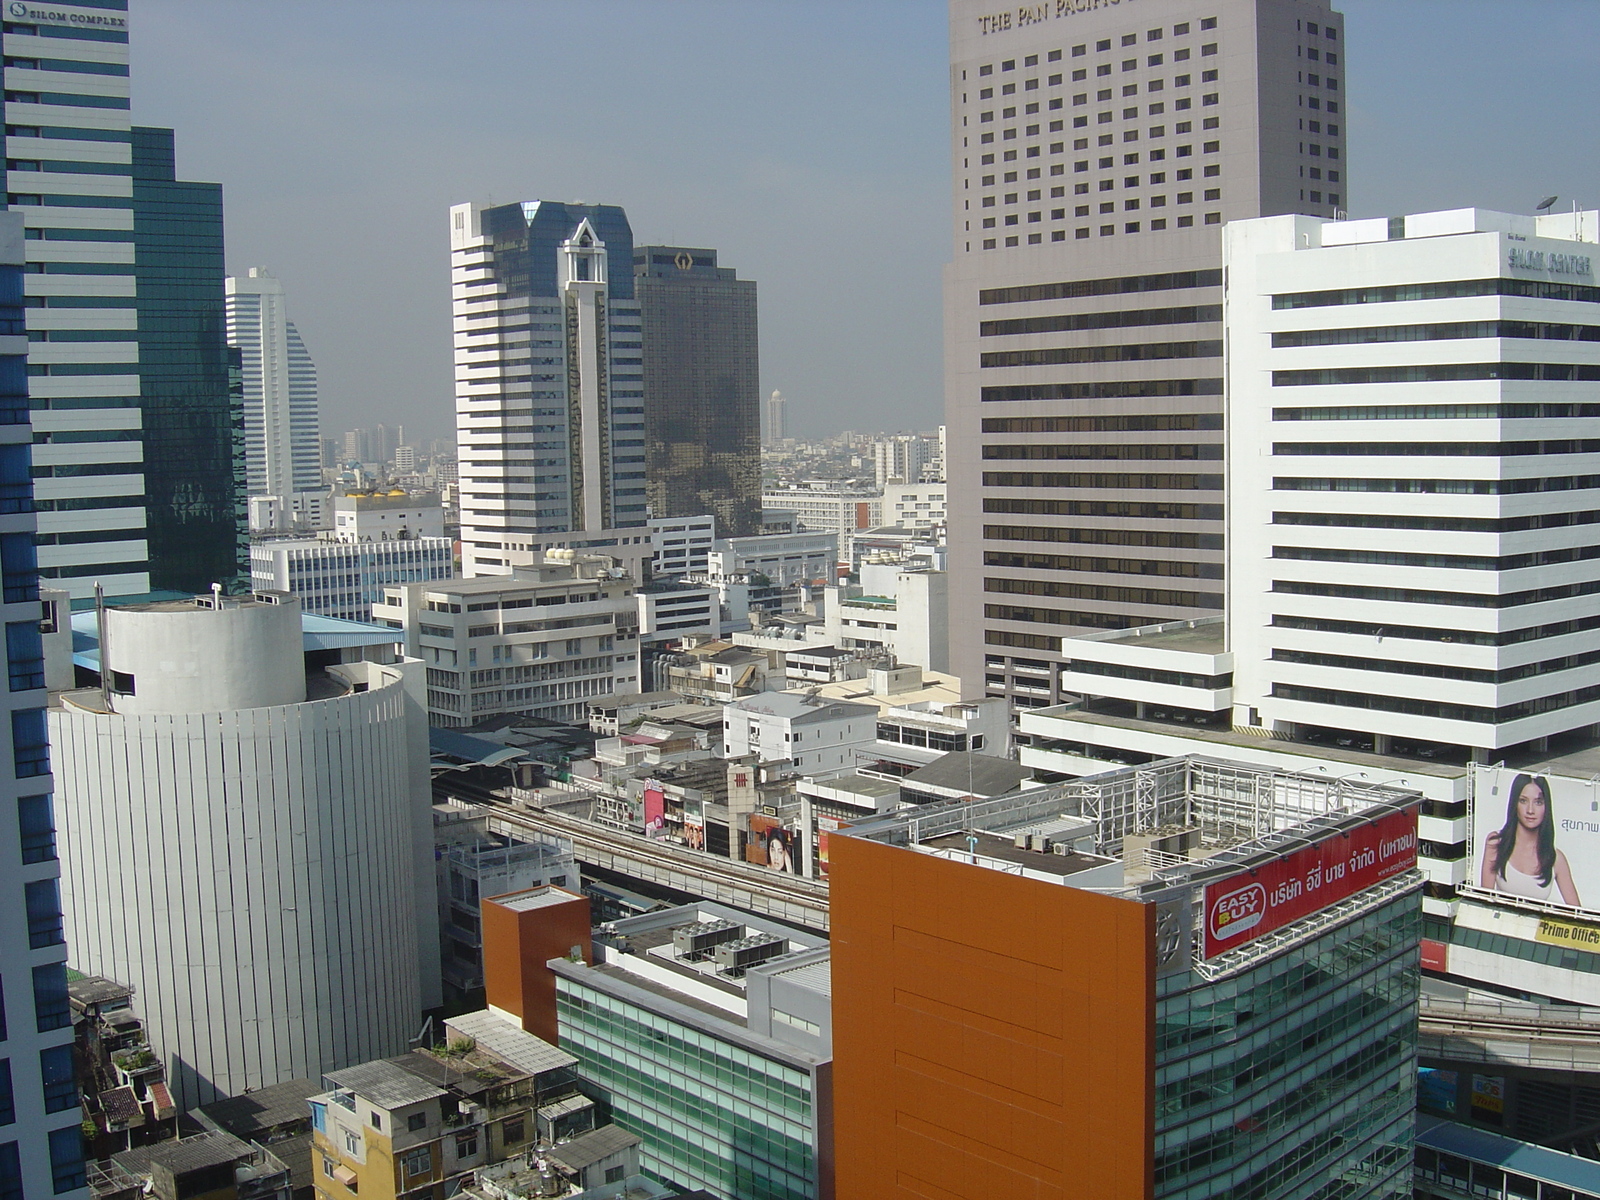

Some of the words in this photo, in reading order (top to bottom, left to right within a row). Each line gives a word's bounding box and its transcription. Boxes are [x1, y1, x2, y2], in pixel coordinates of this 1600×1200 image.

[30, 10, 66, 21] SILOM
[69, 14, 125, 26] COMPLEX
[978, 11, 1012, 35] THE
[1017, 2, 1049, 27] PAN
[1508, 247, 1544, 271] SILOM
[1547, 252, 1591, 276] CENTER
[318, 534, 373, 546] THANIYA
[1270, 878, 1302, 908] บริษัท
[1325, 862, 1345, 884] บาย
[1349, 847, 1375, 873] จำกัด
[1379, 826, 1416, 863] (มหาชน)
[1219, 888, 1259, 913] EASY
[1219, 900, 1259, 925] BUY
[1542, 922, 1570, 939] Prime
[1571, 927, 1600, 944] Office
